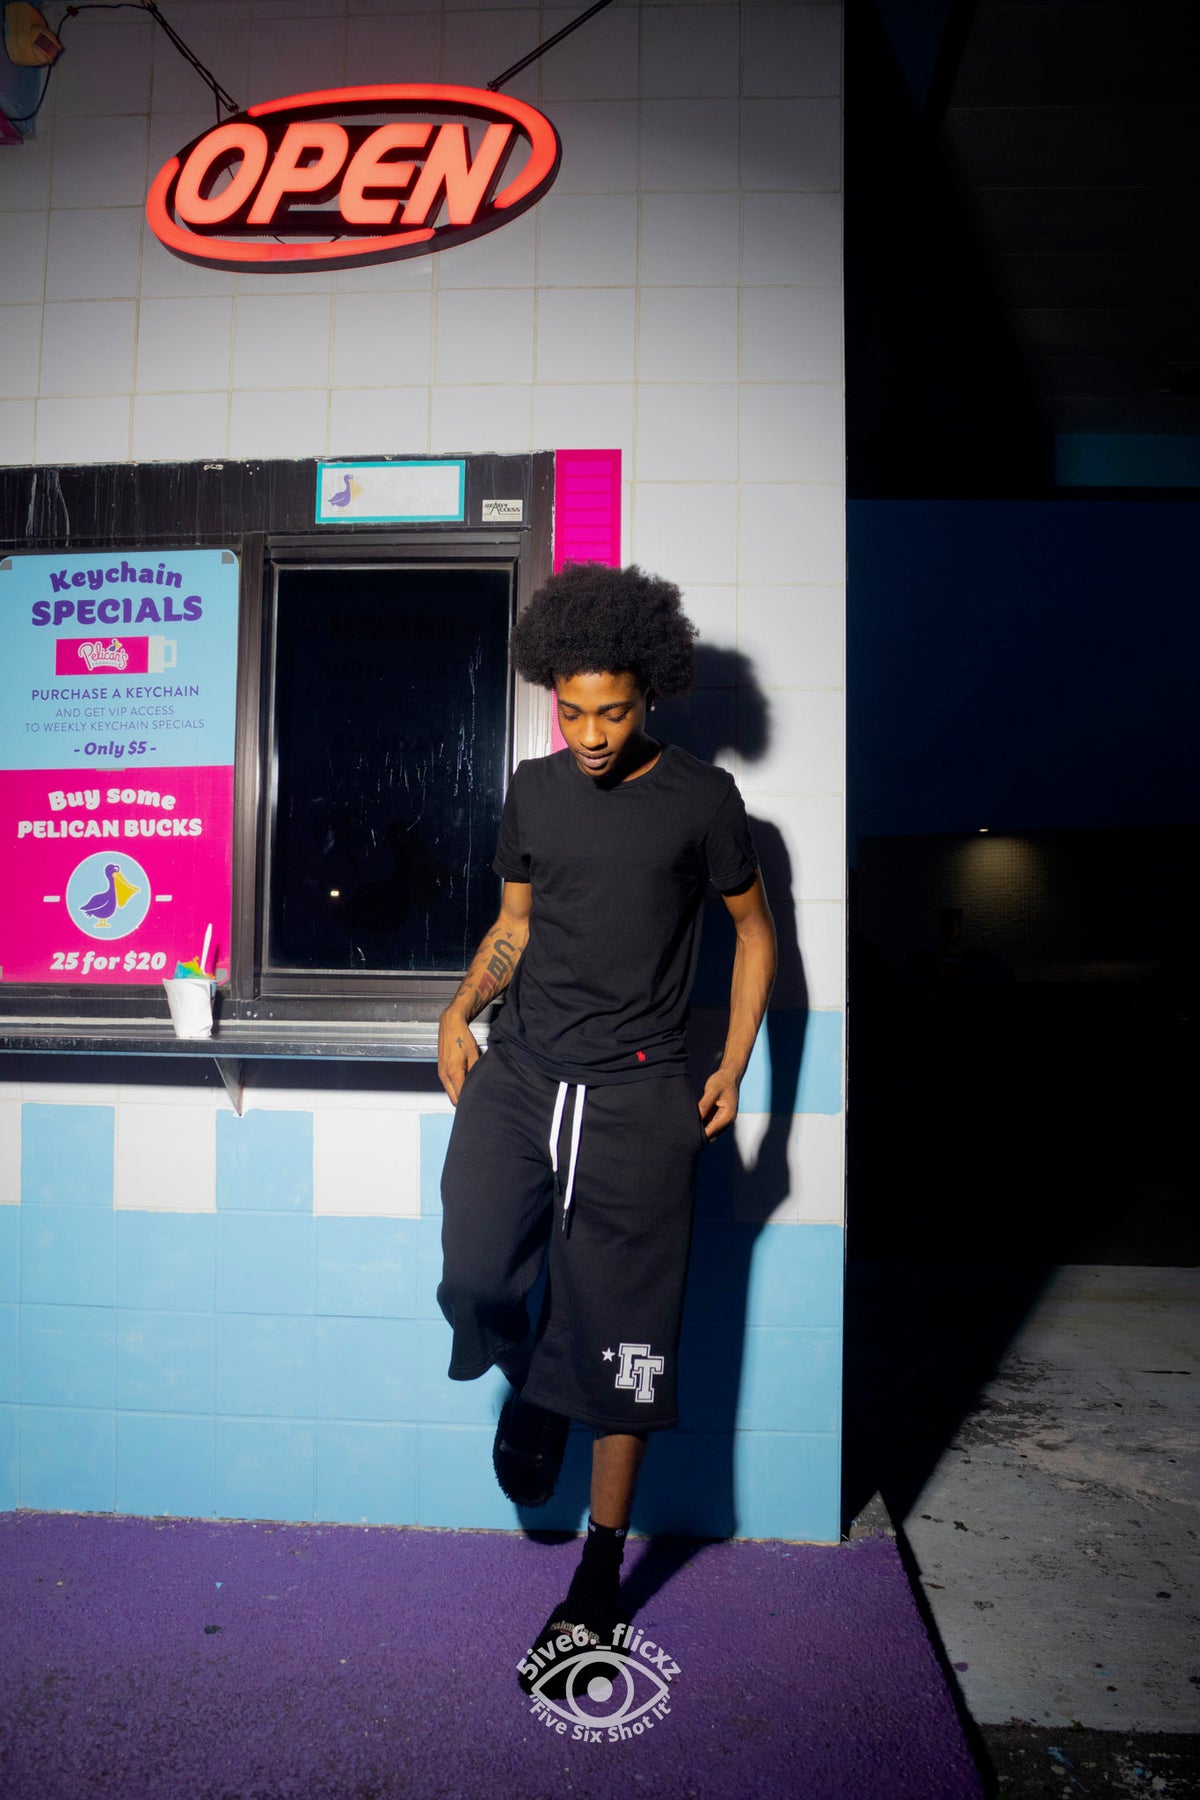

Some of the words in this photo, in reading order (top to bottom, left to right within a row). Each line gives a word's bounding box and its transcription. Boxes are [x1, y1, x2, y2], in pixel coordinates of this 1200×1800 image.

[175, 123, 513, 225] OPEN
[49, 561, 183, 593] Keychain
[31, 595, 203, 627] SPECIALS
[78, 641, 128, 671] Pelican's
[31, 688, 108, 701] PURCHASE
[112, 688, 122, 699] A
[126, 685, 200, 699] KEYCHAIN
[55, 708, 81, 718] AND
[84, 707, 105, 717] GET
[109, 706, 127, 716] VIP
[130, 705, 175, 716] ACCESS
[25, 723, 40, 733] TO
[43, 722, 87, 732] WEEKLY
[90, 720, 149, 731] KEYCHAIN
[152, 719, 205, 730] SPECIALS
[84, 741, 125, 758] Only
[128, 740, 147, 756] $5
[48, 788, 101, 811] Buy
[106, 788, 176, 810] some
[17, 819, 120, 839] PELICAN
[124, 818, 203, 837] BUCKS
[50, 952, 80, 971] 25
[81, 951, 121, 975] for
[123, 950, 167, 972] $20
